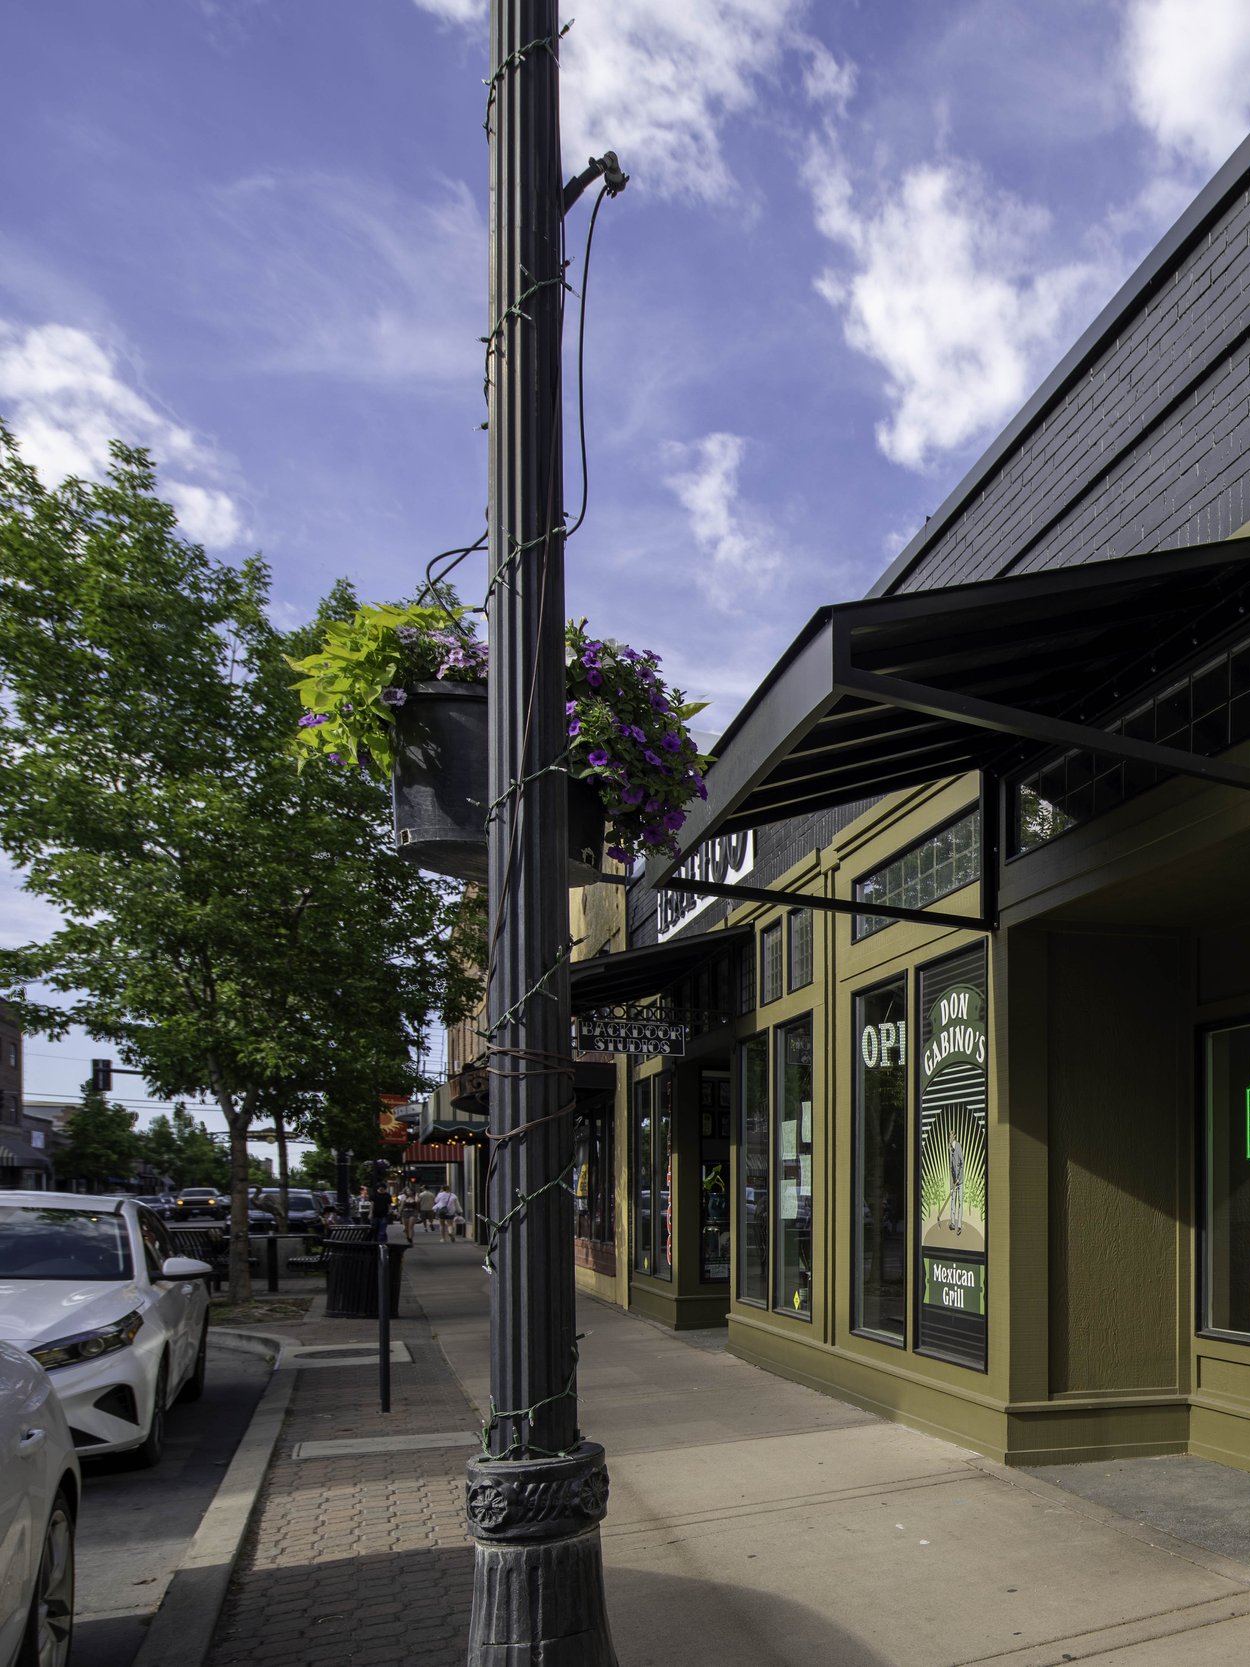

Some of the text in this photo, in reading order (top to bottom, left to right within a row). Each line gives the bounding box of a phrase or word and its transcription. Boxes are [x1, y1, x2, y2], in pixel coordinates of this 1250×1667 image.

[940, 992, 969, 1026] DON
[581, 1021, 682, 1041] BACKDOOR
[594, 1036, 671, 1054] STUDIOS
[924, 1025, 986, 1076] GABINO'S
[933, 1263, 975, 1287] Mexican
[942, 1286, 964, 1308] Grill
